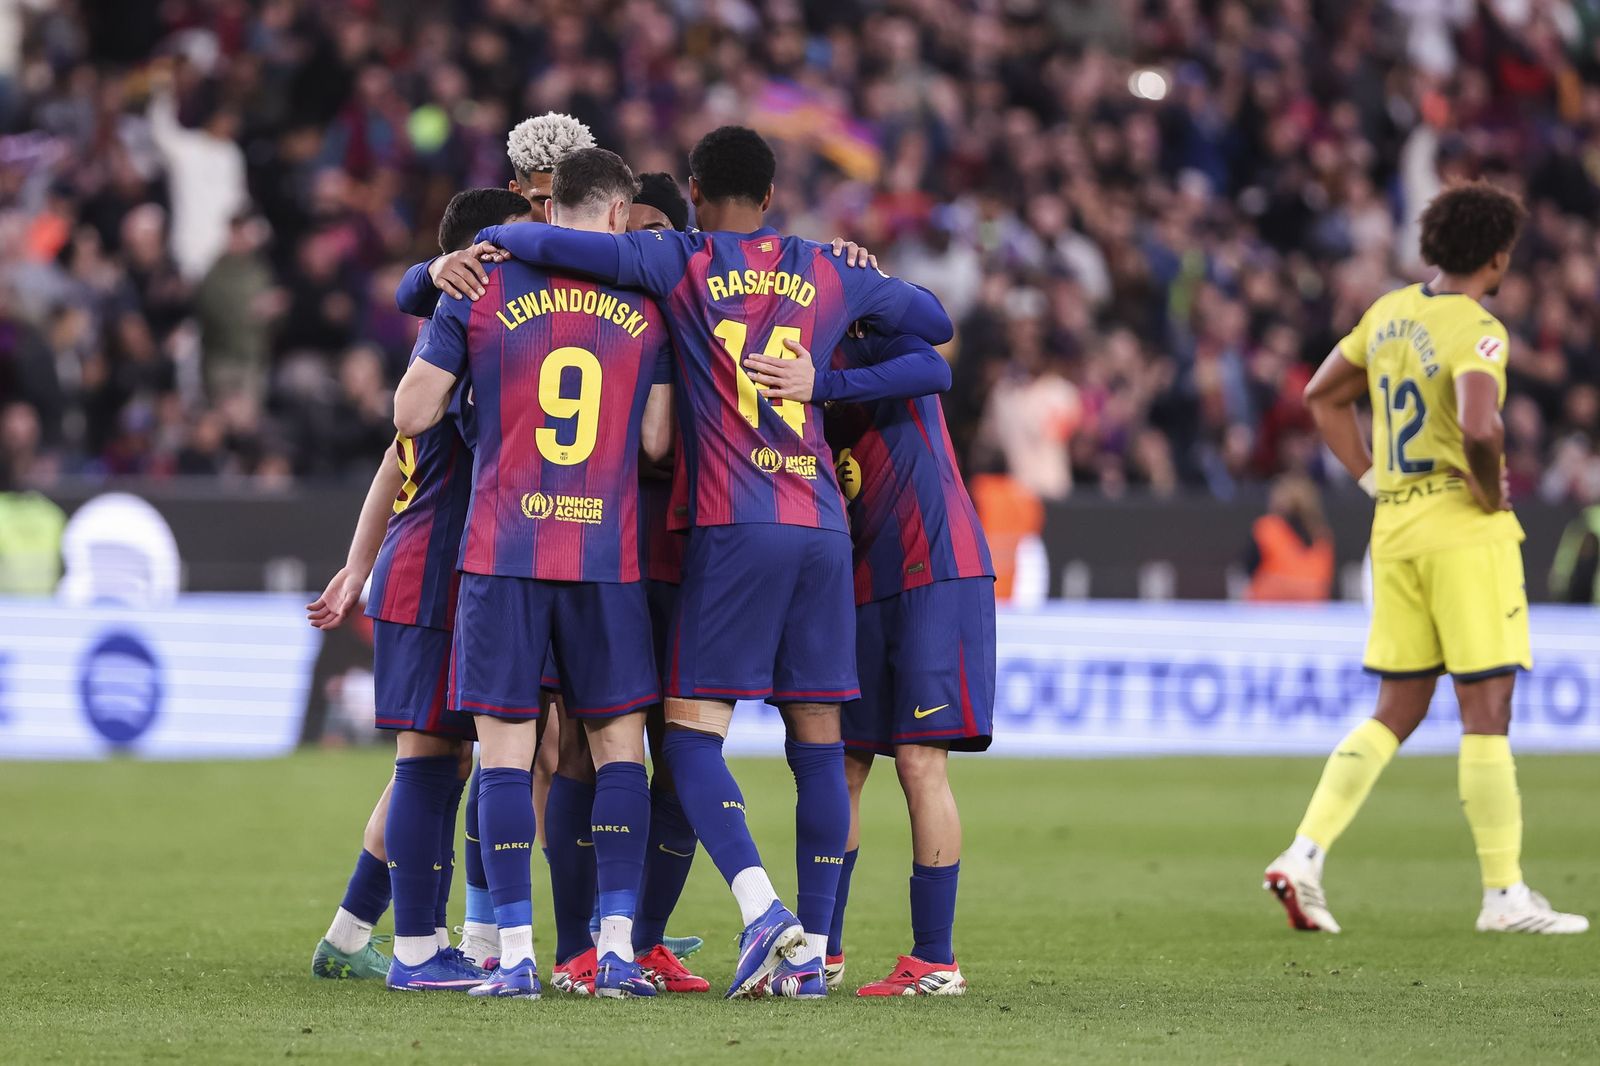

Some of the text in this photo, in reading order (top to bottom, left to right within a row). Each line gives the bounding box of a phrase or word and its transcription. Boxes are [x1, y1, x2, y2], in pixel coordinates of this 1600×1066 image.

[495, 288, 649, 338] LEWANDOWSKI
[534, 346, 603, 466] 9
[713, 318, 806, 440] 14
[1379, 375, 1435, 474] 12
[555, 506, 603, 520] ACNUR
[556, 495, 603, 509] UNHCR
